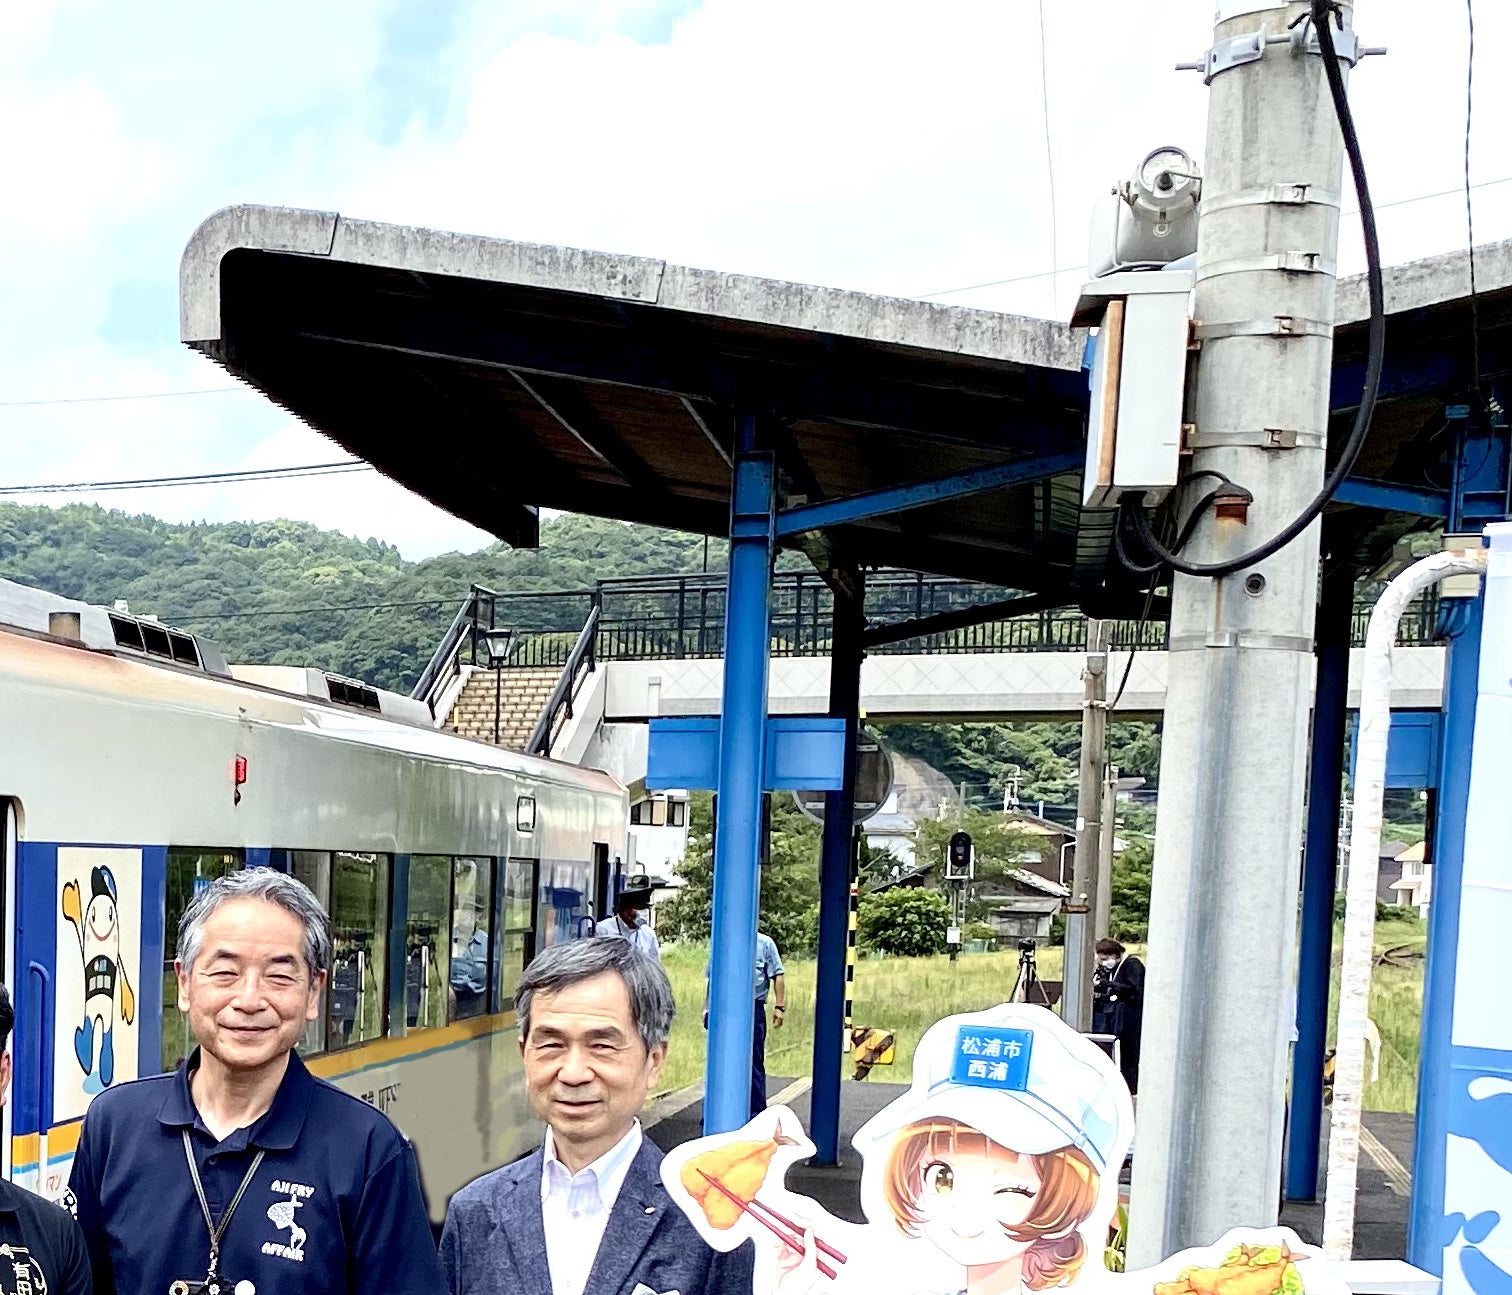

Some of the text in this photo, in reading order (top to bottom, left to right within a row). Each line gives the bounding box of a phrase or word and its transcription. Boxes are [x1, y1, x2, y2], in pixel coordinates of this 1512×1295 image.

[960, 1035, 1023, 1059] 松浦市
[967, 1059, 1010, 1082] 西浦
